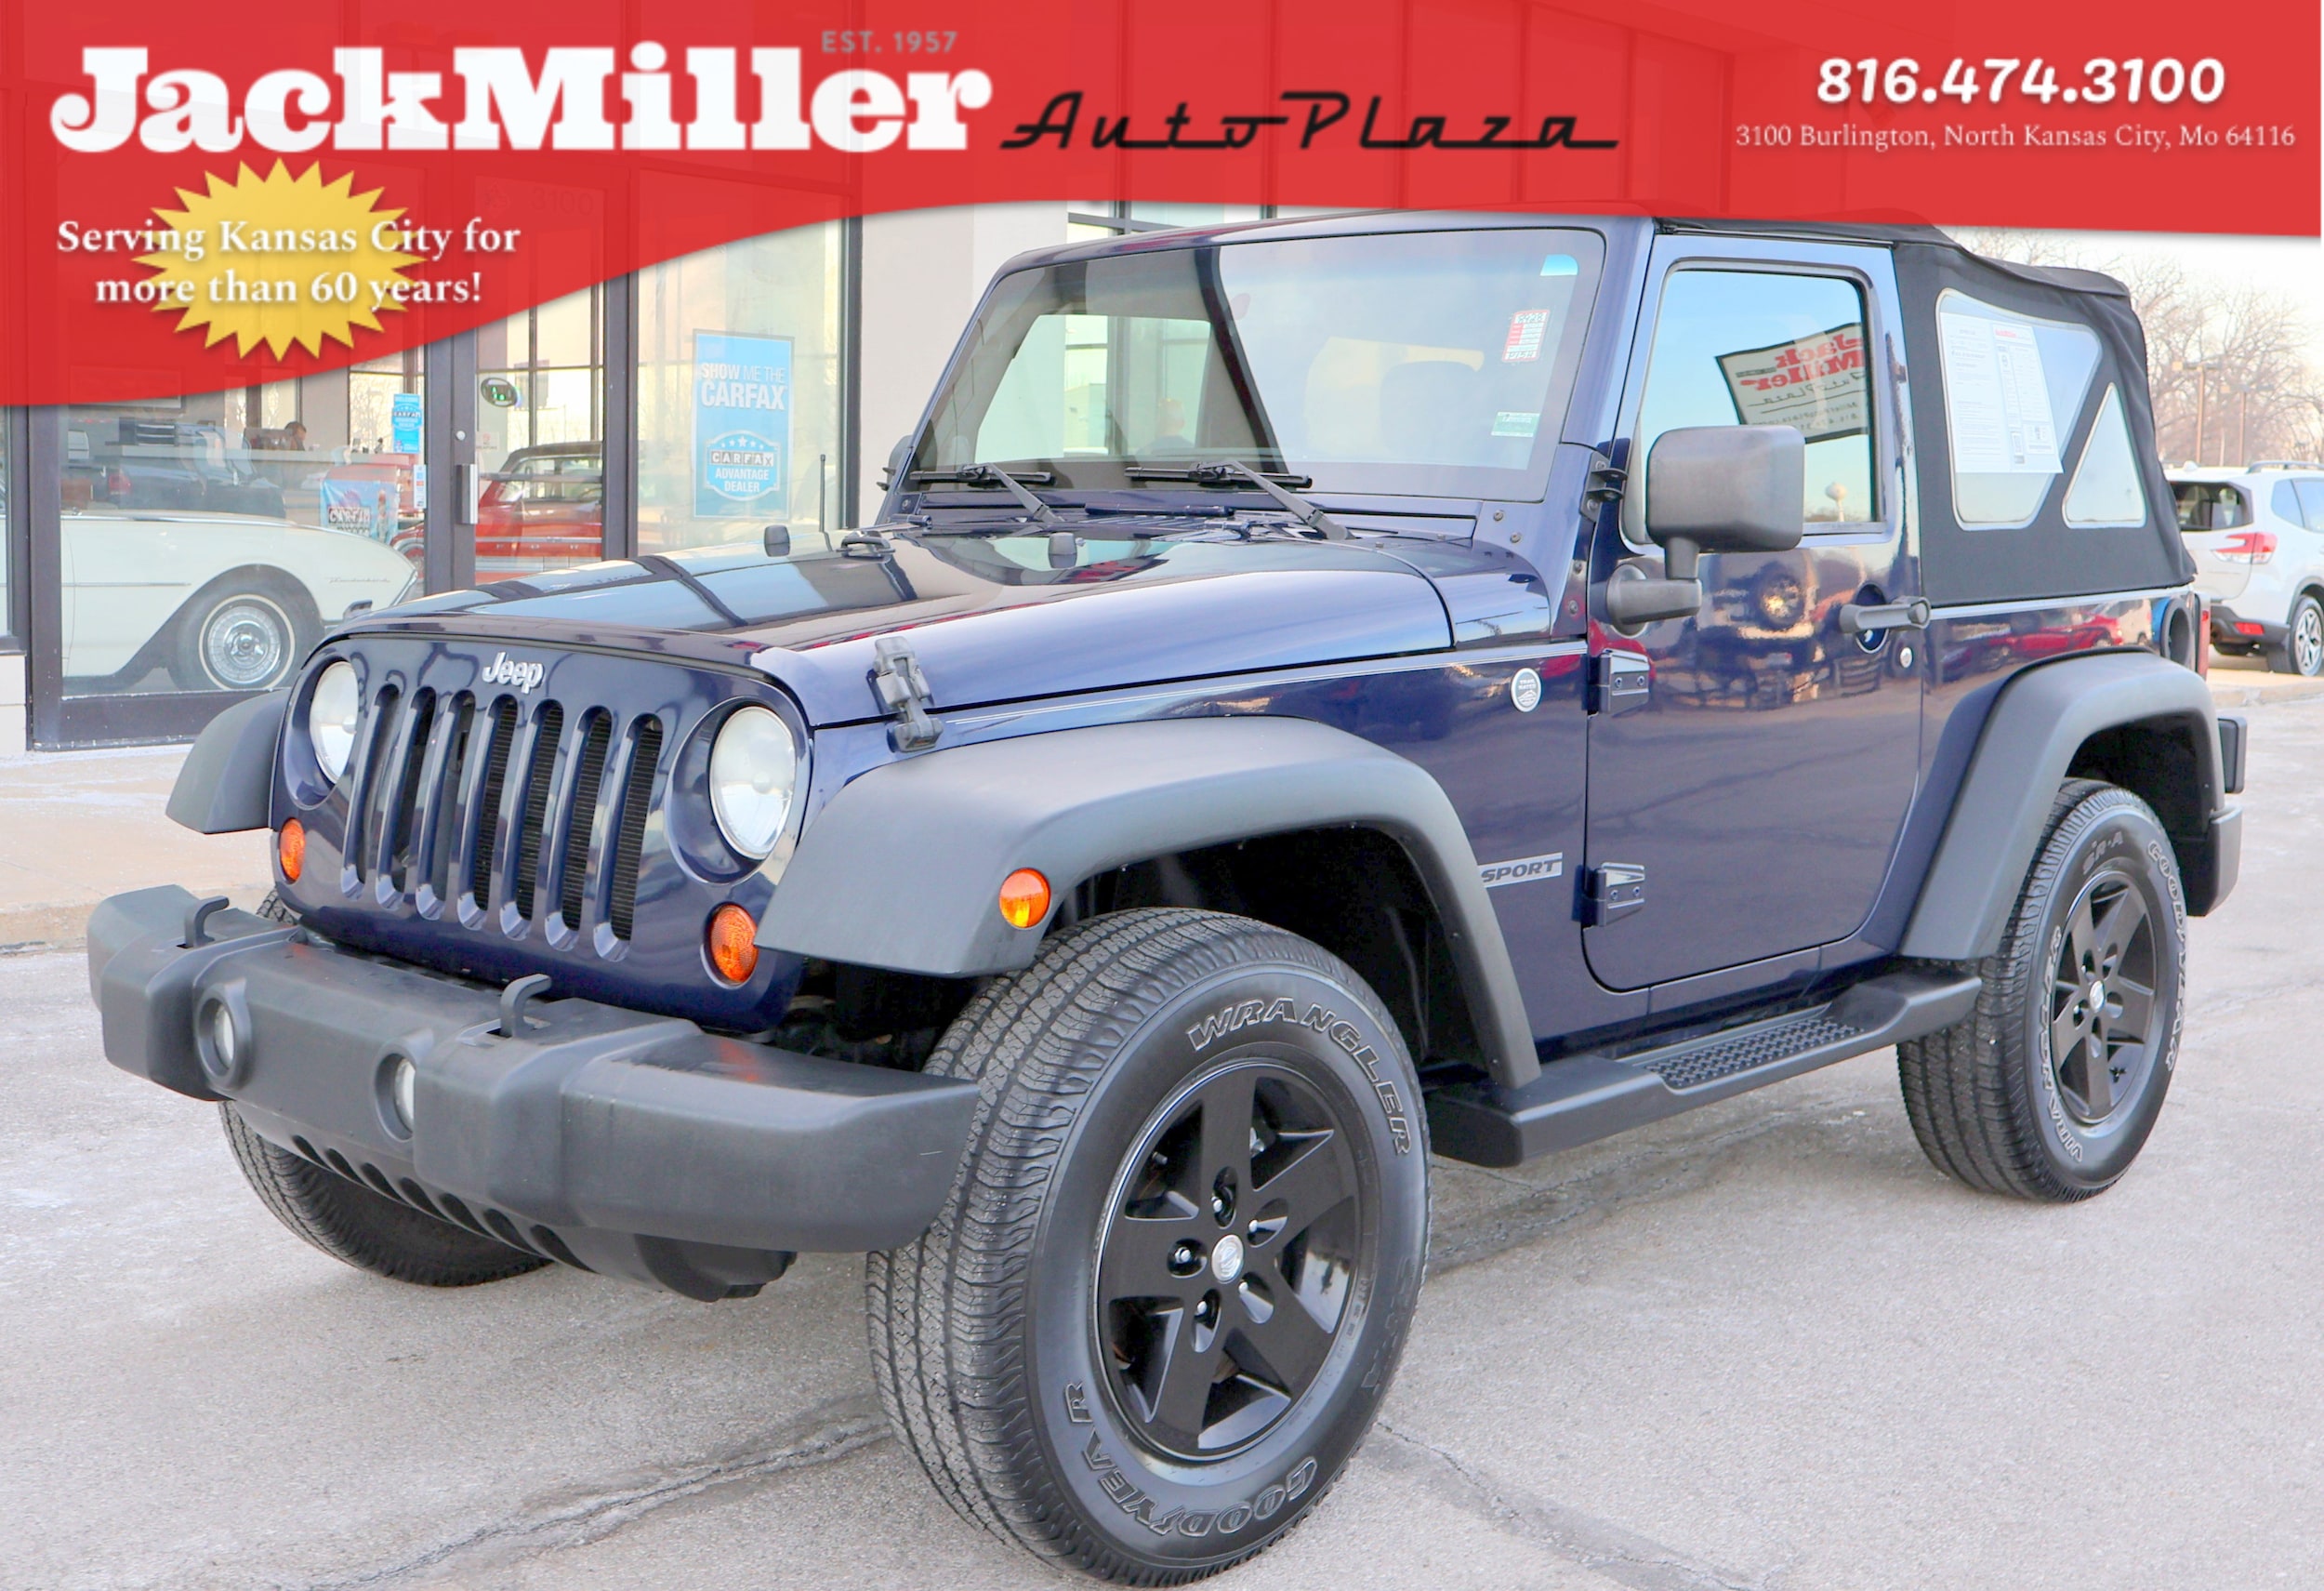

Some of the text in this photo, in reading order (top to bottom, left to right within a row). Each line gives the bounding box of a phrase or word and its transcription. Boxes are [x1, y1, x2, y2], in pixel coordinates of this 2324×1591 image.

[701, 363, 786, 384] SHOW ME THE
[701, 380, 786, 410] CARFAX
[711, 451, 774, 467] CARFAX
[715, 468, 770, 481] ADVANTAGE
[724, 480, 760, 492] DEALER
[482, 651, 546, 695] Jeep
[1480, 858, 1557, 883] SPORT
[1185, 996, 1412, 1157] WRANGLER
[1063, 1382, 1319, 1539] GOODYEAR
